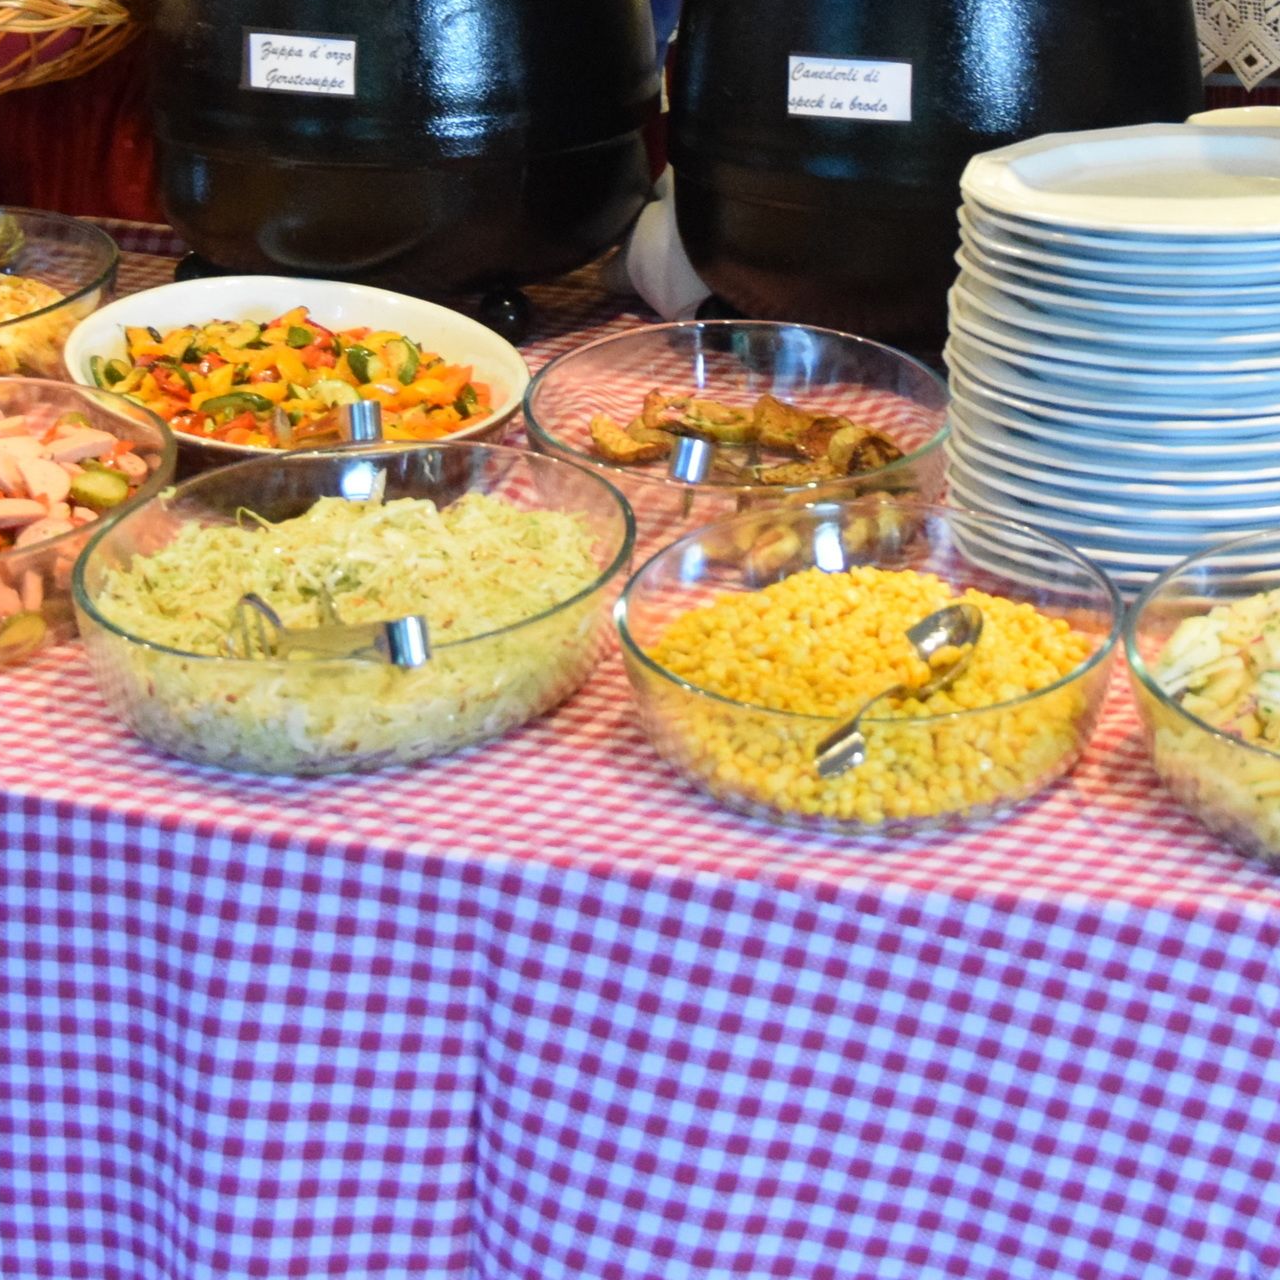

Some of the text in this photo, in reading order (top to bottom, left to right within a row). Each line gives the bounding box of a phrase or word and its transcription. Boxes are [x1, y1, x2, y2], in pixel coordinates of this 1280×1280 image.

[260, 41, 303, 60] Zuppa
[266, 68, 346, 90] Gerstesuppe
[791, 62, 880, 83] Canederli di
[788, 94, 888, 112] speck in brodo
